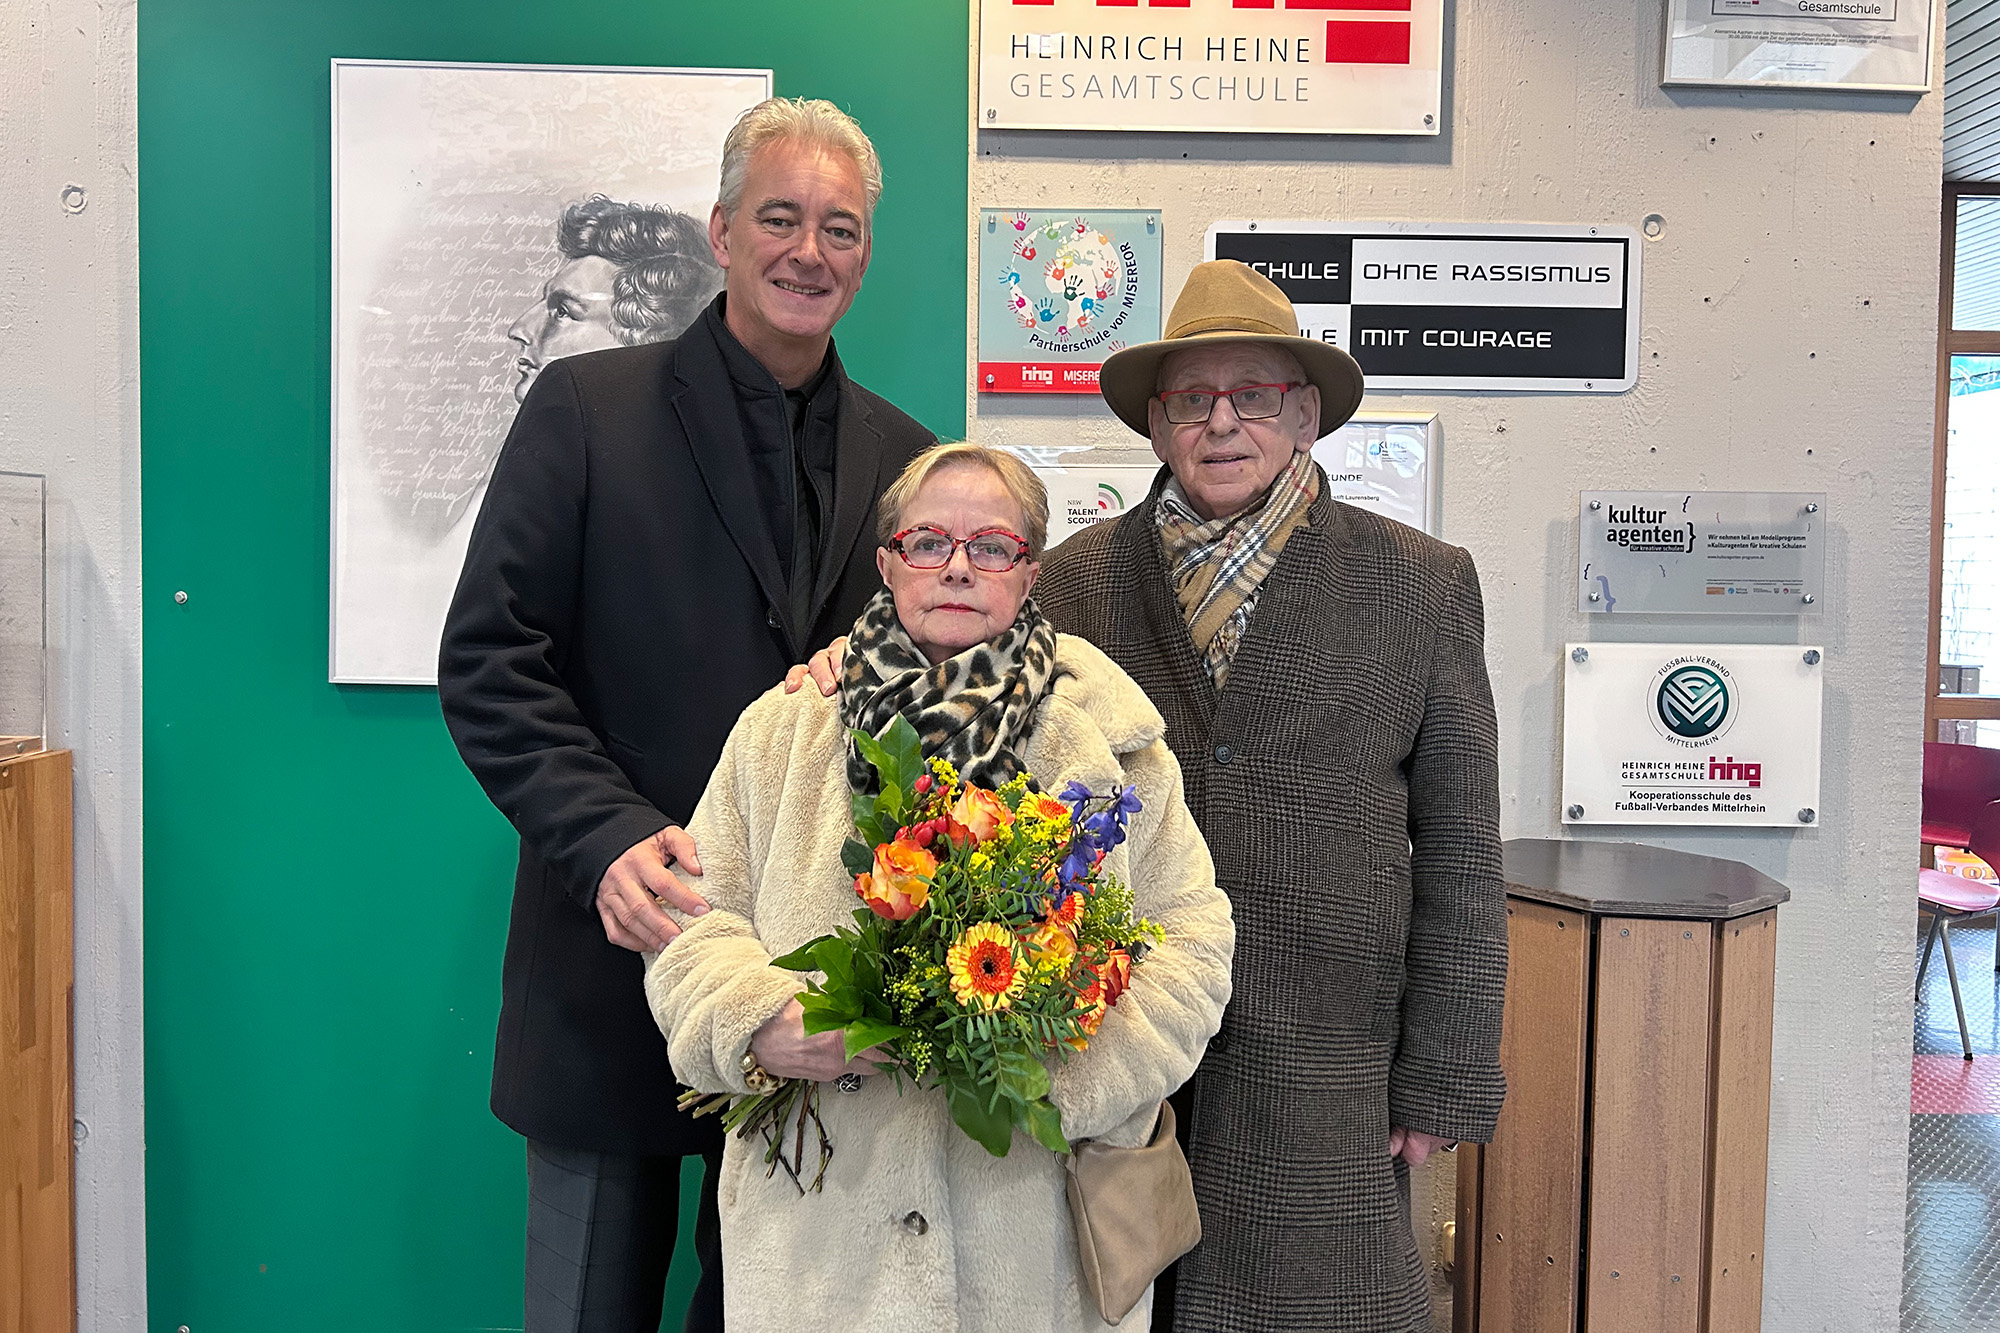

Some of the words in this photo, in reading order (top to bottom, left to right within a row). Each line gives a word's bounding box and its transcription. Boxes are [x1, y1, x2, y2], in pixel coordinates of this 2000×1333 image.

[1798, 1, 1881, 14] Gesamtschule
[1012, 35, 1182, 60] HEINRICH
[1206, 37, 1310, 62] HEINE
[1011, 73, 1309, 102] GESAMTSCHULE
[1119, 241, 1139, 309] MISEREOR
[1242, 262, 1339, 280] CHULE
[1363, 263, 1438, 281] OHNE
[1452, 264, 1611, 285] RASSISMUS
[1110, 311, 1129, 331] von
[1029, 330, 1111, 353] Partnerschule
[1360, 328, 1410, 347] MIT
[1422, 330, 1552, 349] COURAGE
[1064, 370, 1100, 382] MISERE
[1325, 474, 1363, 482] KUNDE
[1609, 505, 1667, 523] kultur
[1658, 656, 1730, 678] FUSSBALL-VERBAND
[1665, 735, 1719, 748] MITTELRHEIN
[1622, 762, 1671, 770] HEINRICH
[1675, 762, 1706, 770] HEINE
[1622, 772, 1706, 780] GESAMTSCHULE
[1629, 790, 1731, 802] Kooperationsschule
[1733, 792, 1752, 801] des
[1615, 802, 1709, 812] Fußball-Verbandes
[1712, 803, 1767, 813] Mittelrhein
